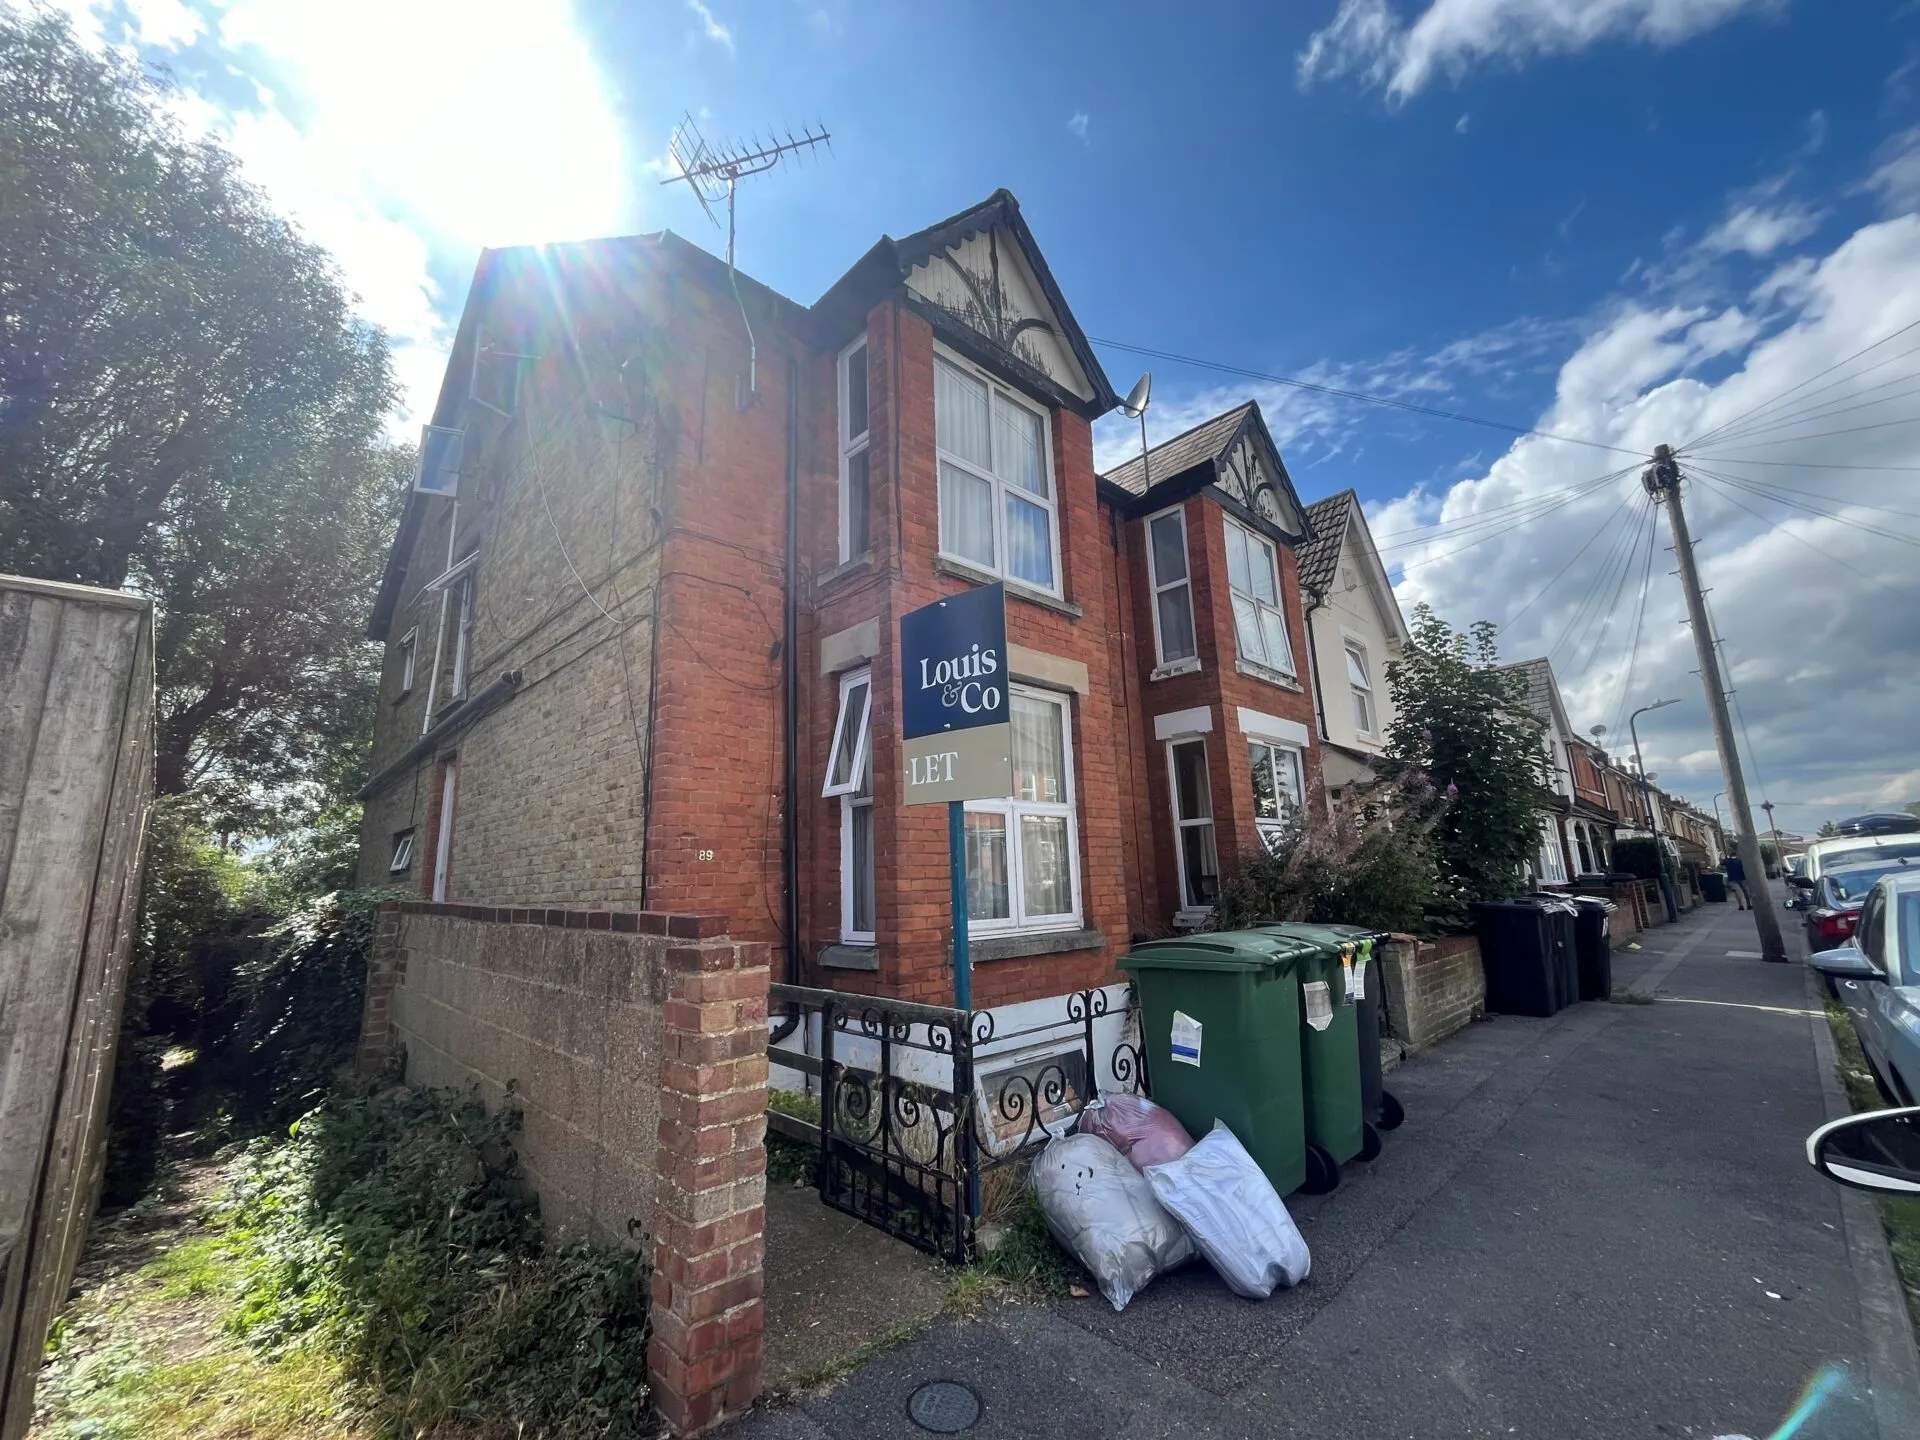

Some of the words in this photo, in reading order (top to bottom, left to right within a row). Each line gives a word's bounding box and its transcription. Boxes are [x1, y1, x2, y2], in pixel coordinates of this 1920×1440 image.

[920, 643, 997, 690] Louis
[910, 751, 958, 785] LET
[698, 849, 713, 861] 89
